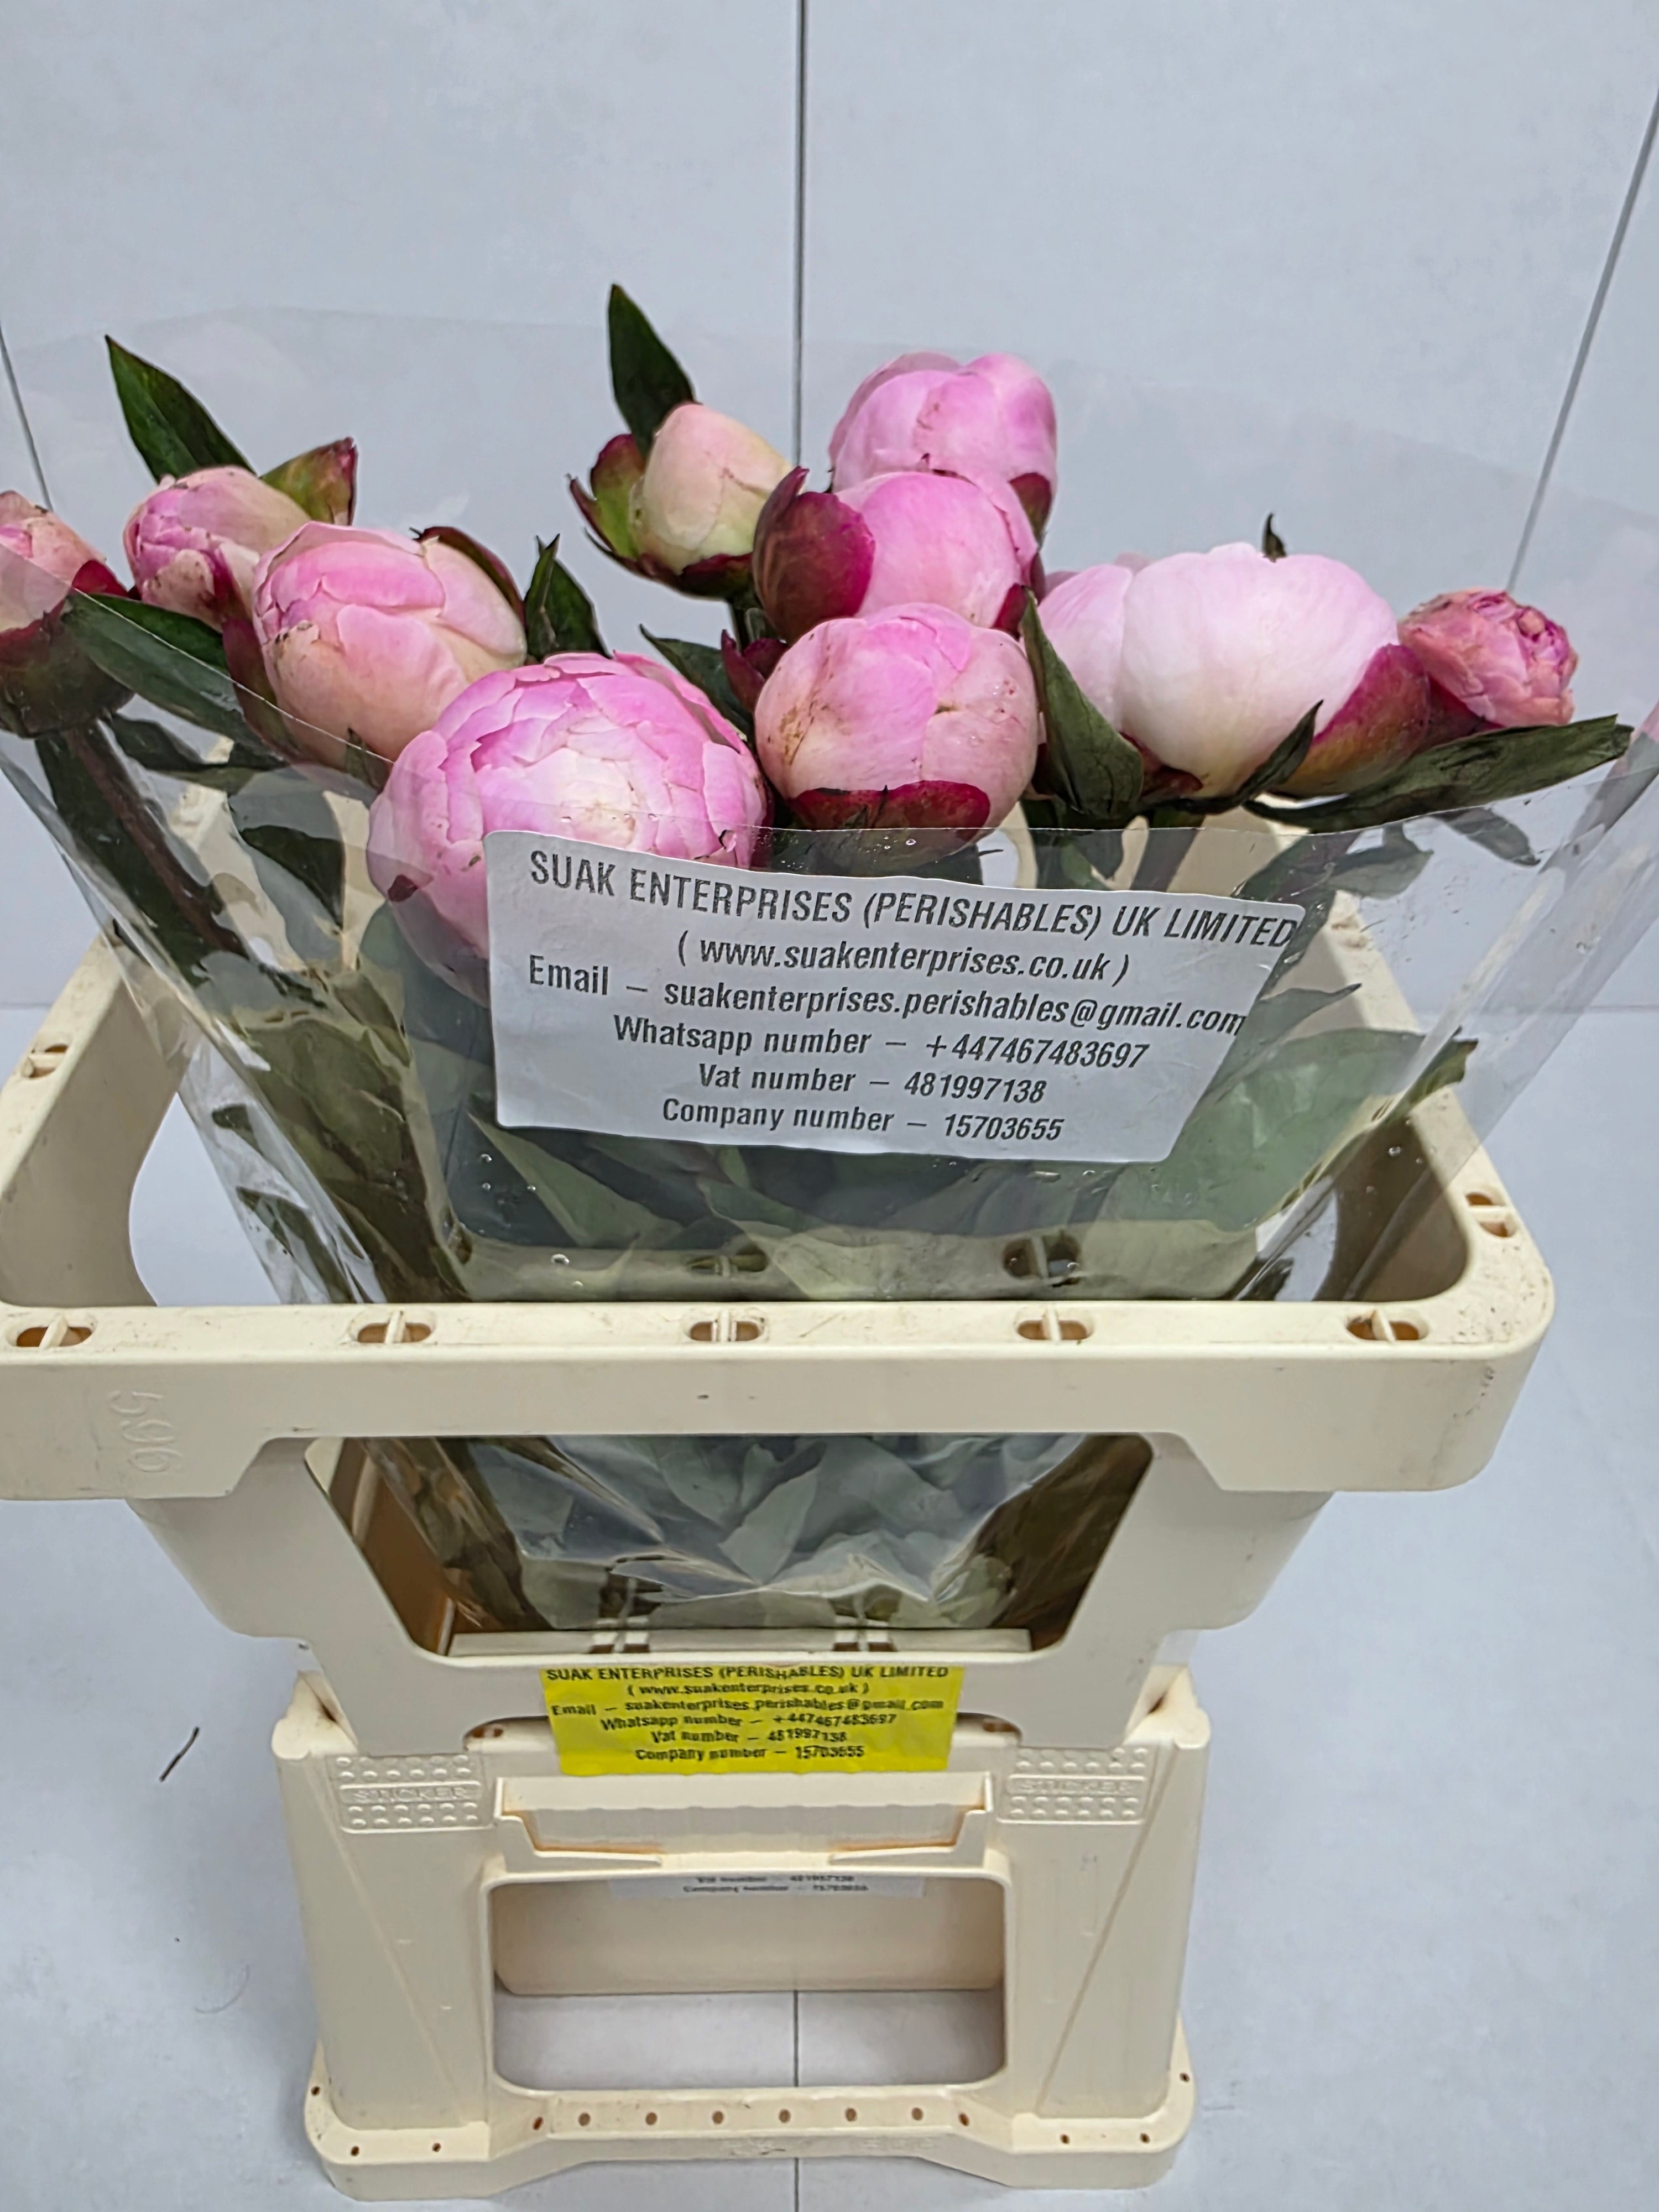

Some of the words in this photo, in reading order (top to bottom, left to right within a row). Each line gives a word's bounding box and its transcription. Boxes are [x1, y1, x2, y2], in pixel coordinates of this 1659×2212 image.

[530, 850, 615, 896] SUAK
[630, 868, 852, 923] ENTERPRISES
[864, 891, 1101, 940] (PERISHABLES)
[1112, 906, 1161, 937] UK
[1164, 908, 1298, 947] LIMITED
[700, 939, 1110, 980] www.suakenterprises.co.uk
[530, 954, 609, 995] Email
[664, 982, 1246, 1036] suakenterprises.perishables@gmail.com
[614, 1014, 752, 1056] Whatsapp
[764, 1028, 872, 1055] number
[700, 1063, 740, 1089] Vat
[751, 1067, 856, 1092] number
[904, 1072, 1047, 1103] 481997138
[663, 1098, 784, 1131] Company
[793, 1105, 895, 1132] number
[945, 1114, 1065, 1140] 15703655
[547, 1668, 593, 1681] SUAK
[598, 1667, 713, 1680] ENTERPRISES
[719, 1665, 845, 1680] (PERISHABLES)
[851, 1666, 873, 1677] UK
[880, 1666, 948, 1678] LIMITED
[551, 1704, 597, 1715] Email
[601, 1714, 679, 1730] Whatsapp
[684, 1714, 743, 1727] number
[635, 1748, 705, 1762] Company
[709, 1748, 768, 1760] number
[651, 1730, 675, 1743] Vat
[681, 1730, 739, 1743] number
